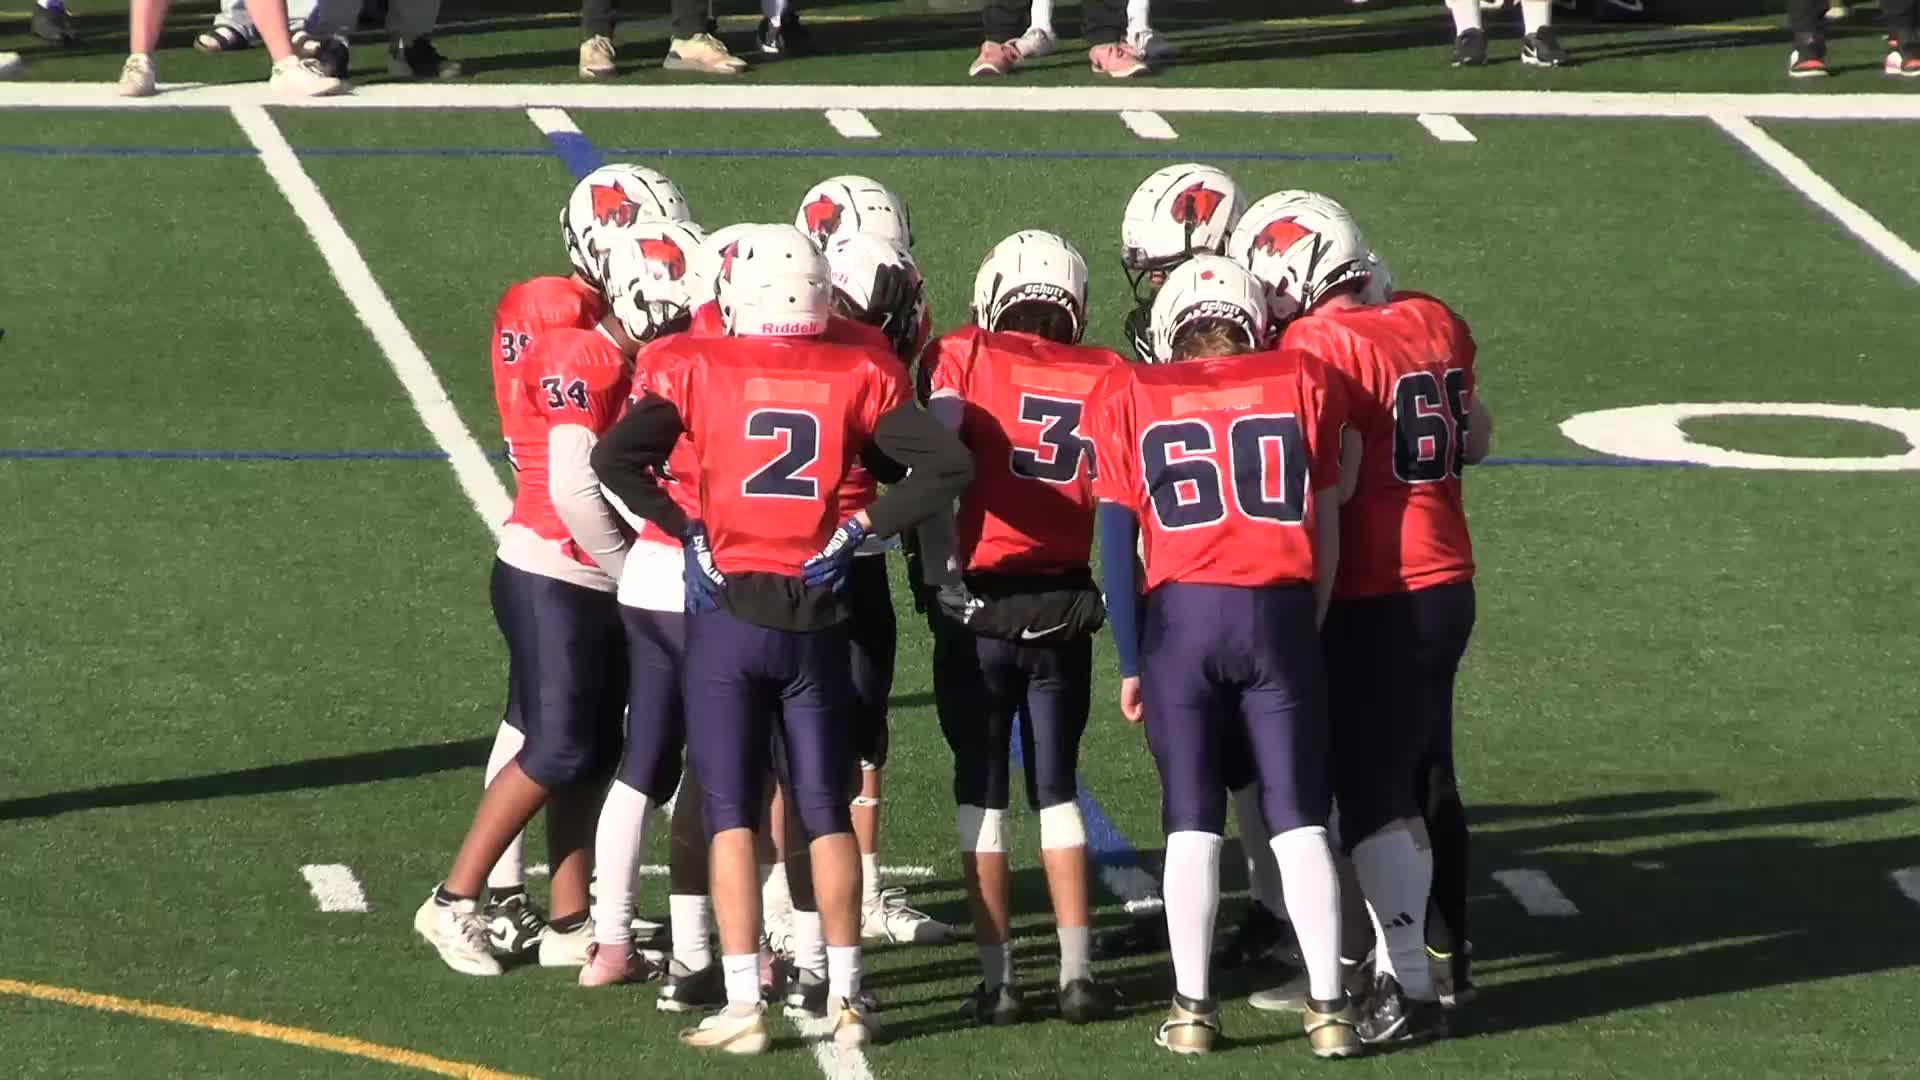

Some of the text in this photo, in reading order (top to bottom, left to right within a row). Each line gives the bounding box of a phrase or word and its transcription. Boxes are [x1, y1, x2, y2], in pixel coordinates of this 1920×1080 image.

[762, 322, 817, 334] Riddell
[540, 375, 588, 412] 34
[1009, 391, 1086, 485] 3
[742, 408, 820, 500] 2
[1139, 412, 1310, 532] 60
